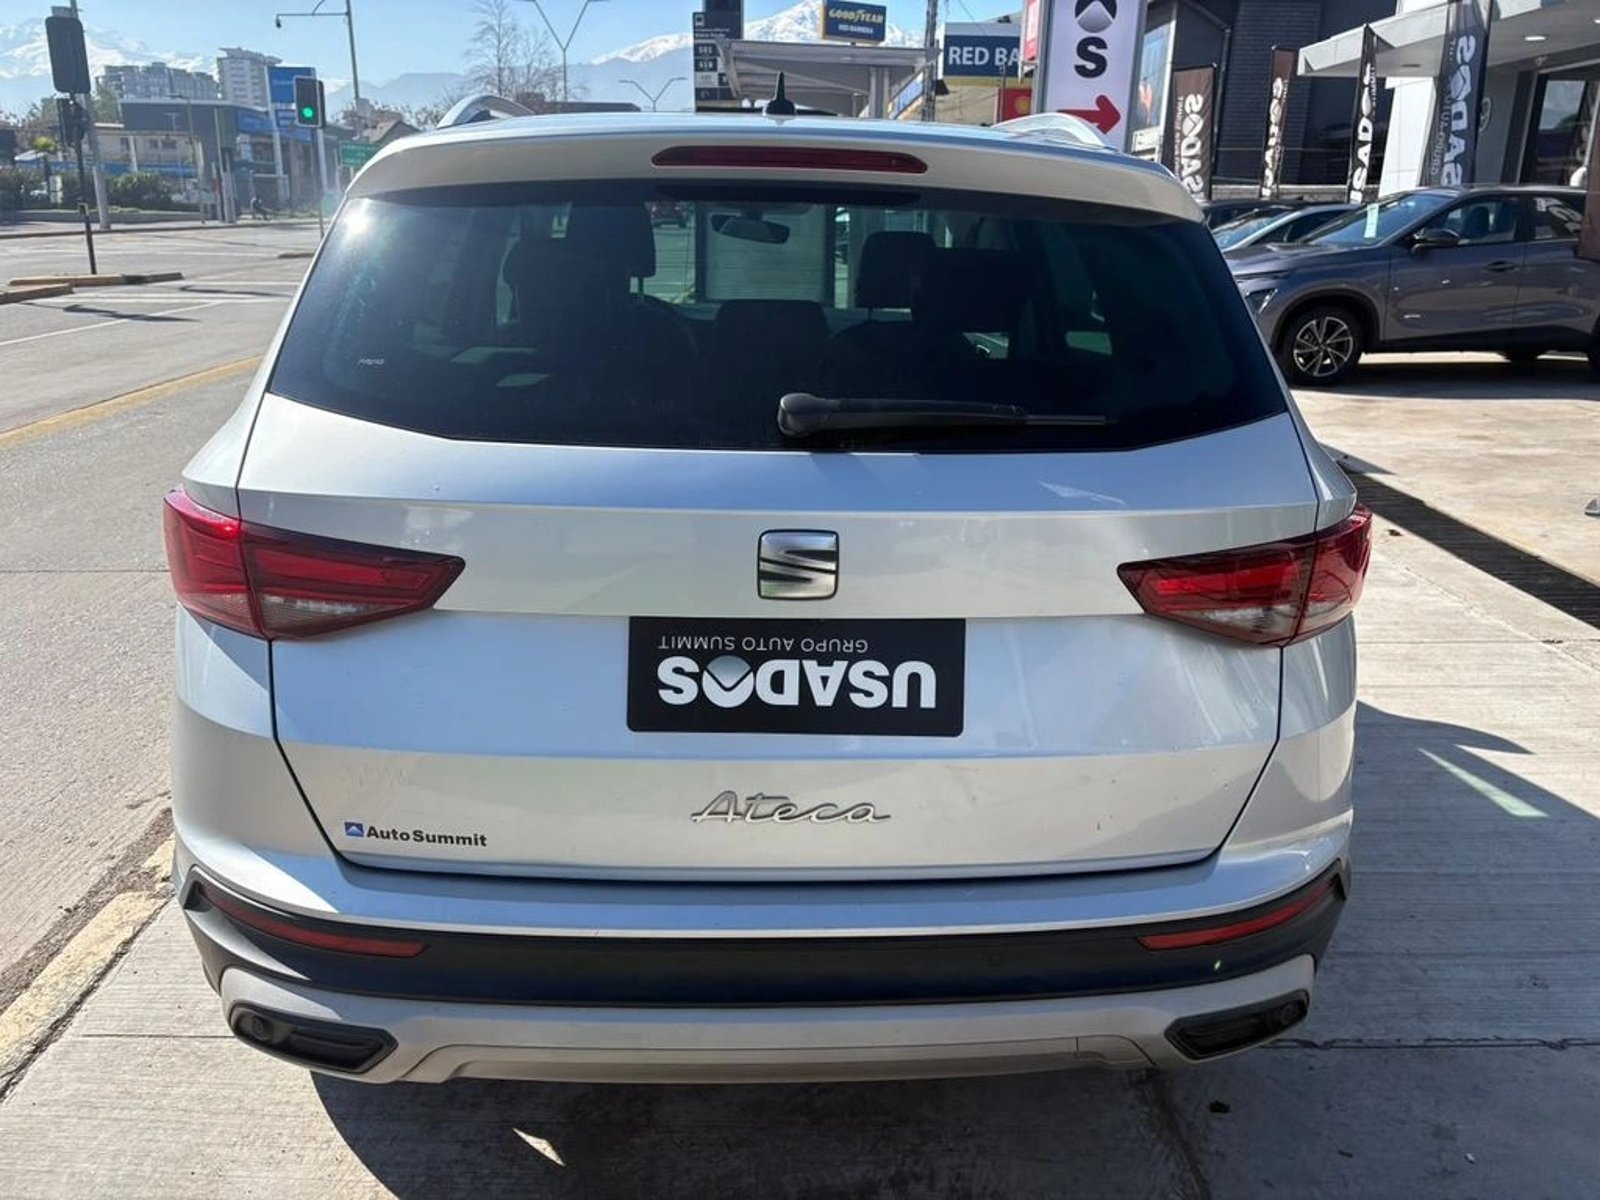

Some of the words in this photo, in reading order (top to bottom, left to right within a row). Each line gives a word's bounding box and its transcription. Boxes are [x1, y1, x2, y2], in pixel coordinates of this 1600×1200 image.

[829, 8, 884, 23] GOODYEAR
[949, 46, 990, 66] RED
[657, 636, 735, 650] SUMMIT
[742, 637, 795, 651] AUTO
[801, 638, 869, 653] GRUPO
[657, 655, 937, 709] USADOS
[690, 790, 892, 824] Ateca
